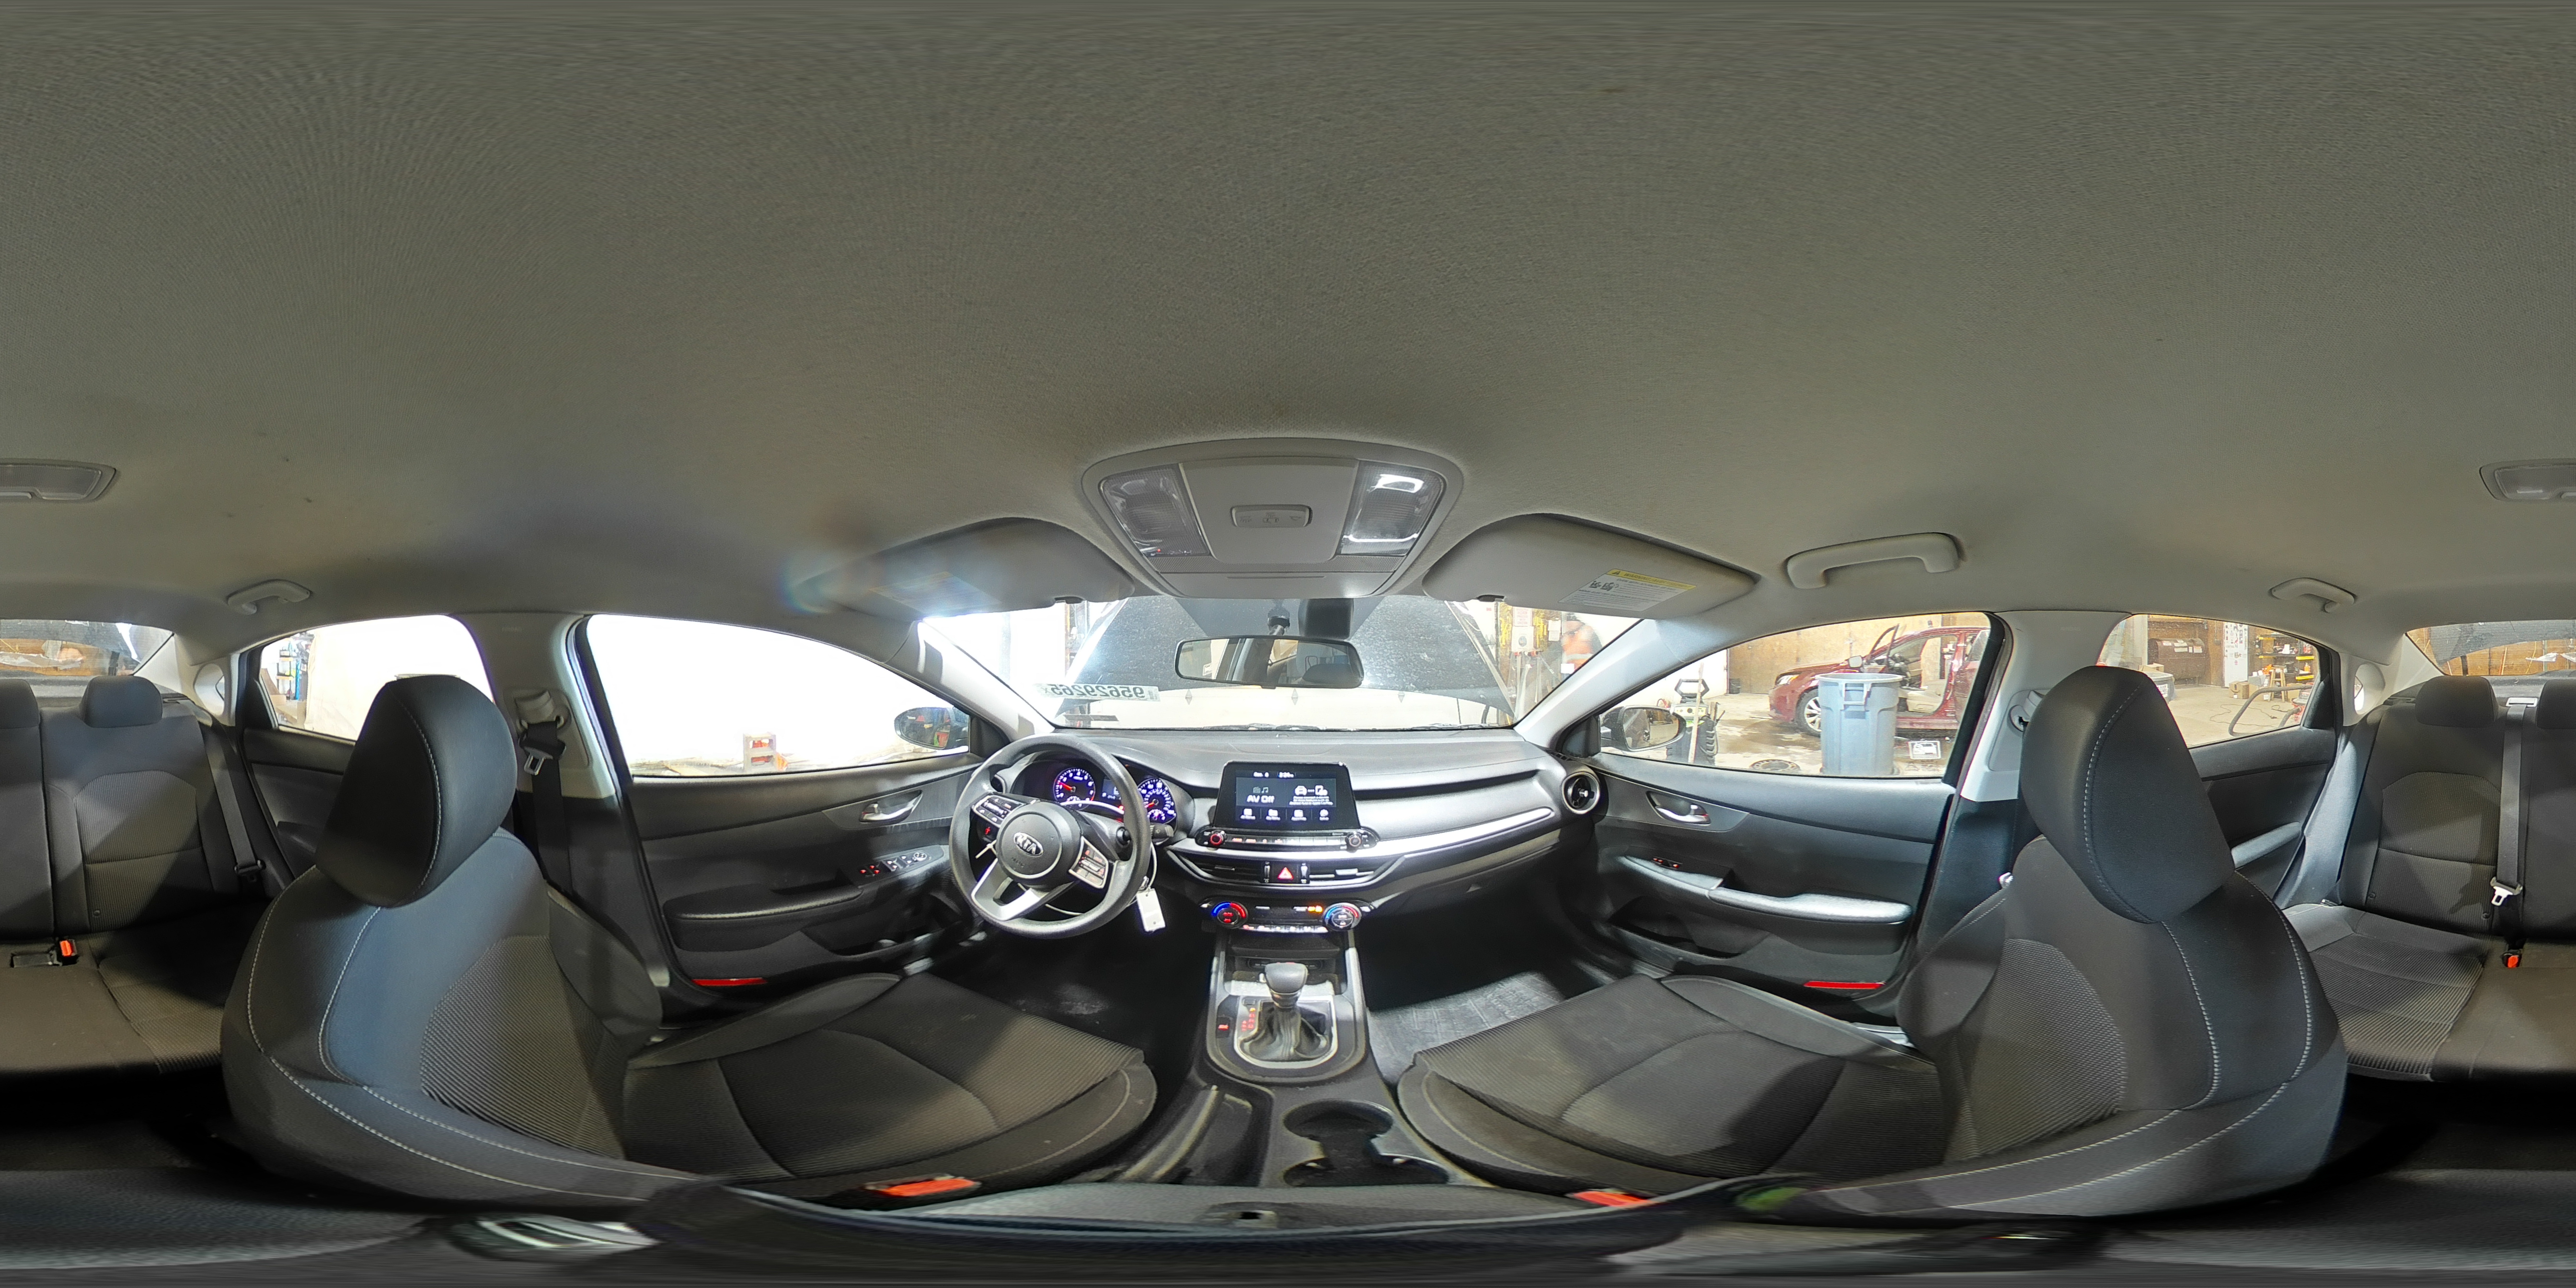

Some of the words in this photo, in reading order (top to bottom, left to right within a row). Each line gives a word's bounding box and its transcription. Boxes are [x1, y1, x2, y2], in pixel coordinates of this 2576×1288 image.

[1246, 795, 1260, 803] AV
[1261, 795, 1275, 804] Off
[1015, 834, 1036, 854] KIA
